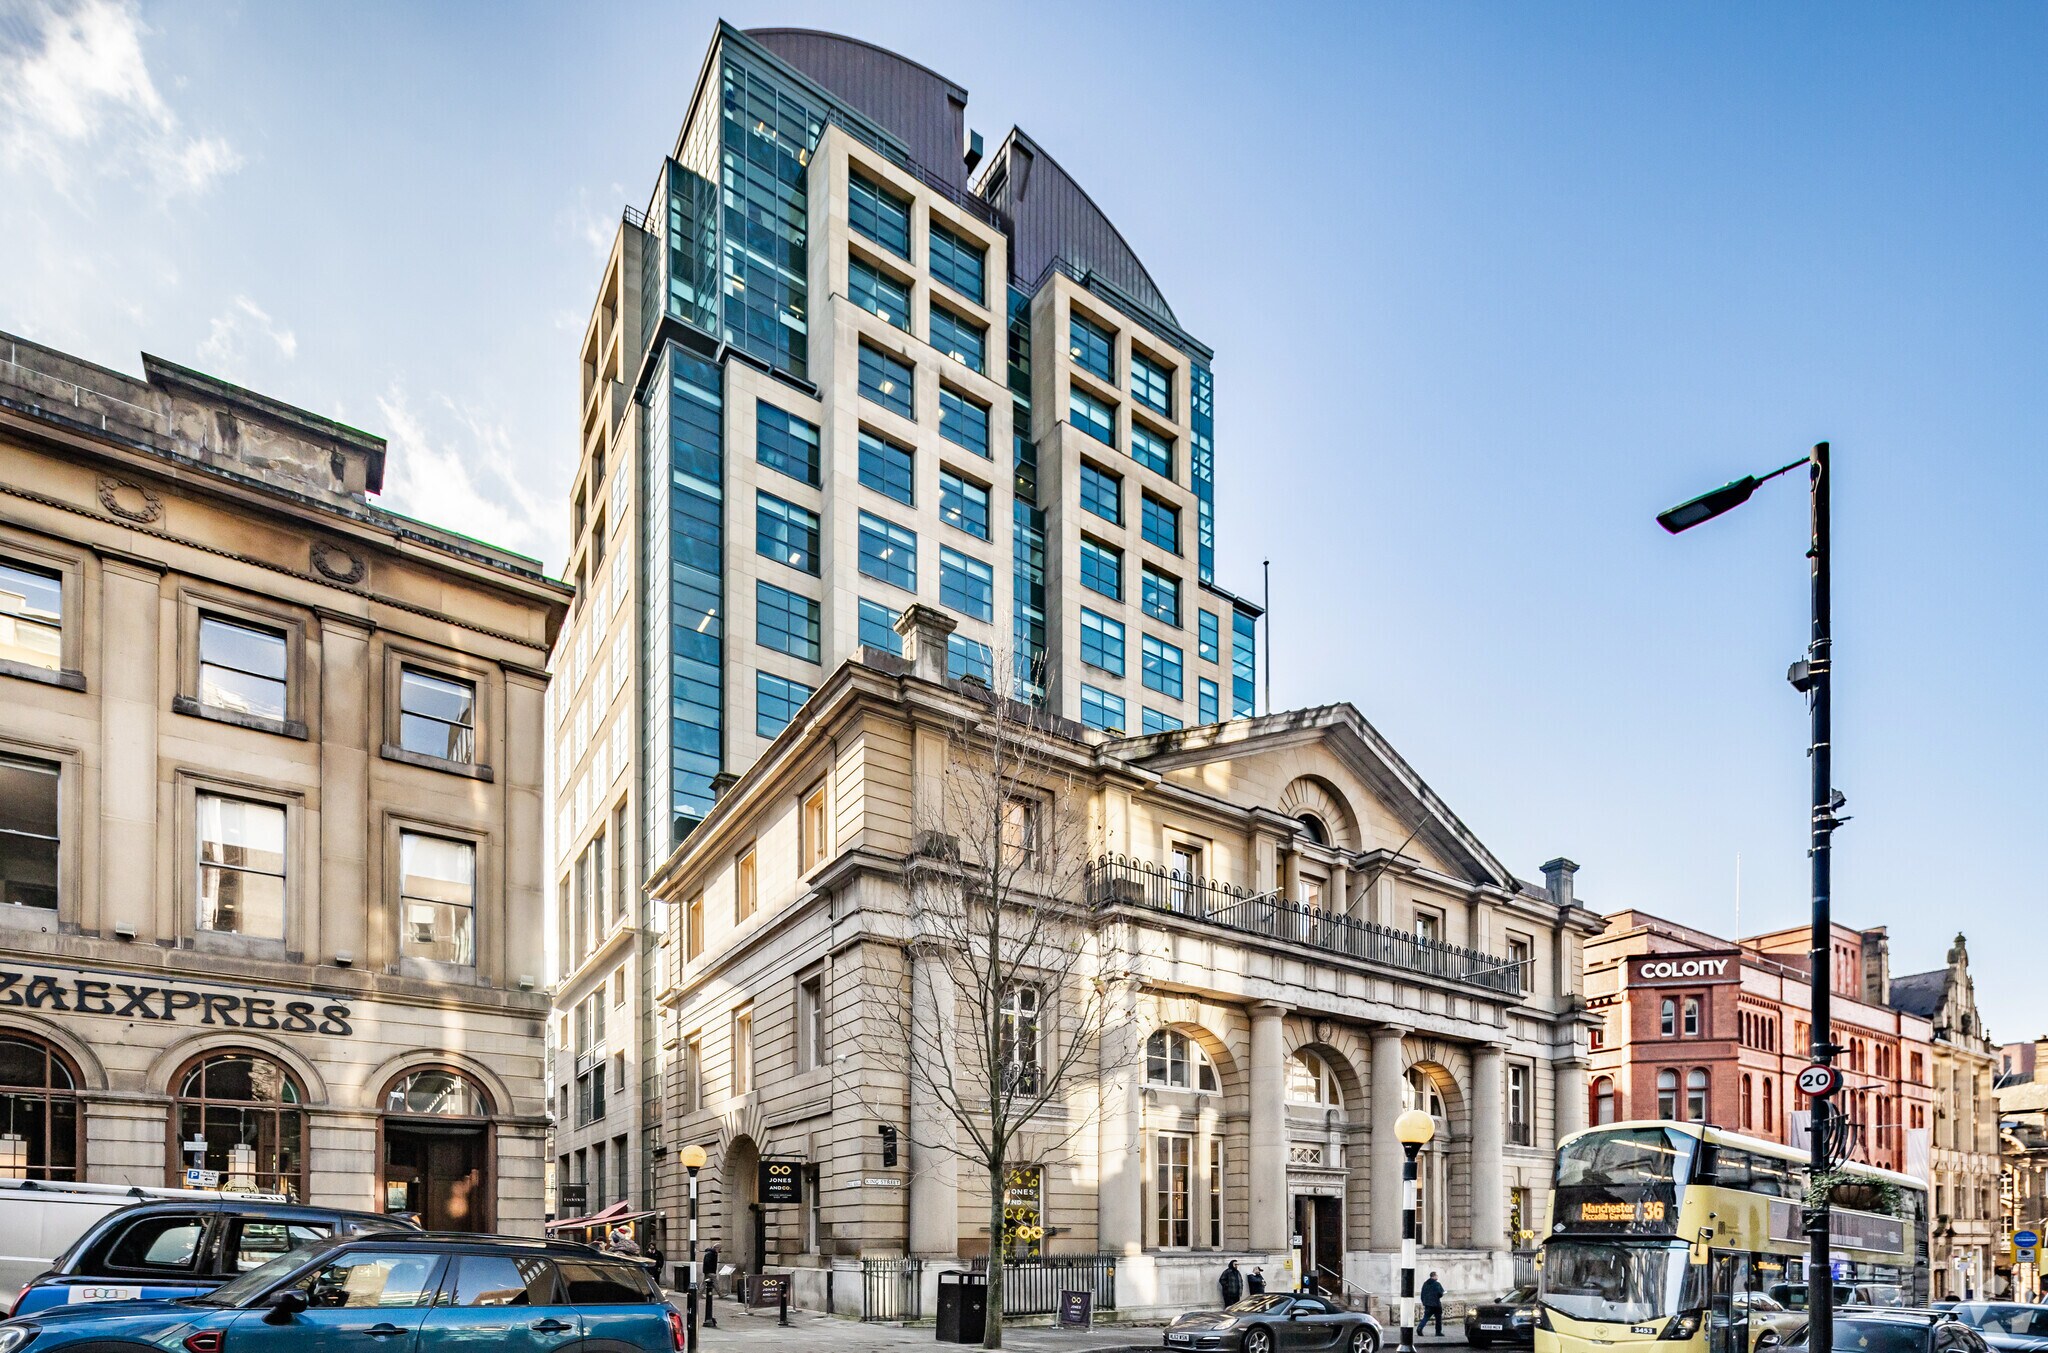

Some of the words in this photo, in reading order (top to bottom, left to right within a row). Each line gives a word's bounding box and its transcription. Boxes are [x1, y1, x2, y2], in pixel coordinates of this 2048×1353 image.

[1640, 959, 1729, 979] COLONY
[1802, 1073, 1828, 1087] 20
[1582, 1203, 1635, 1214] Manchester
[1643, 1202, 1664, 1220] 36
